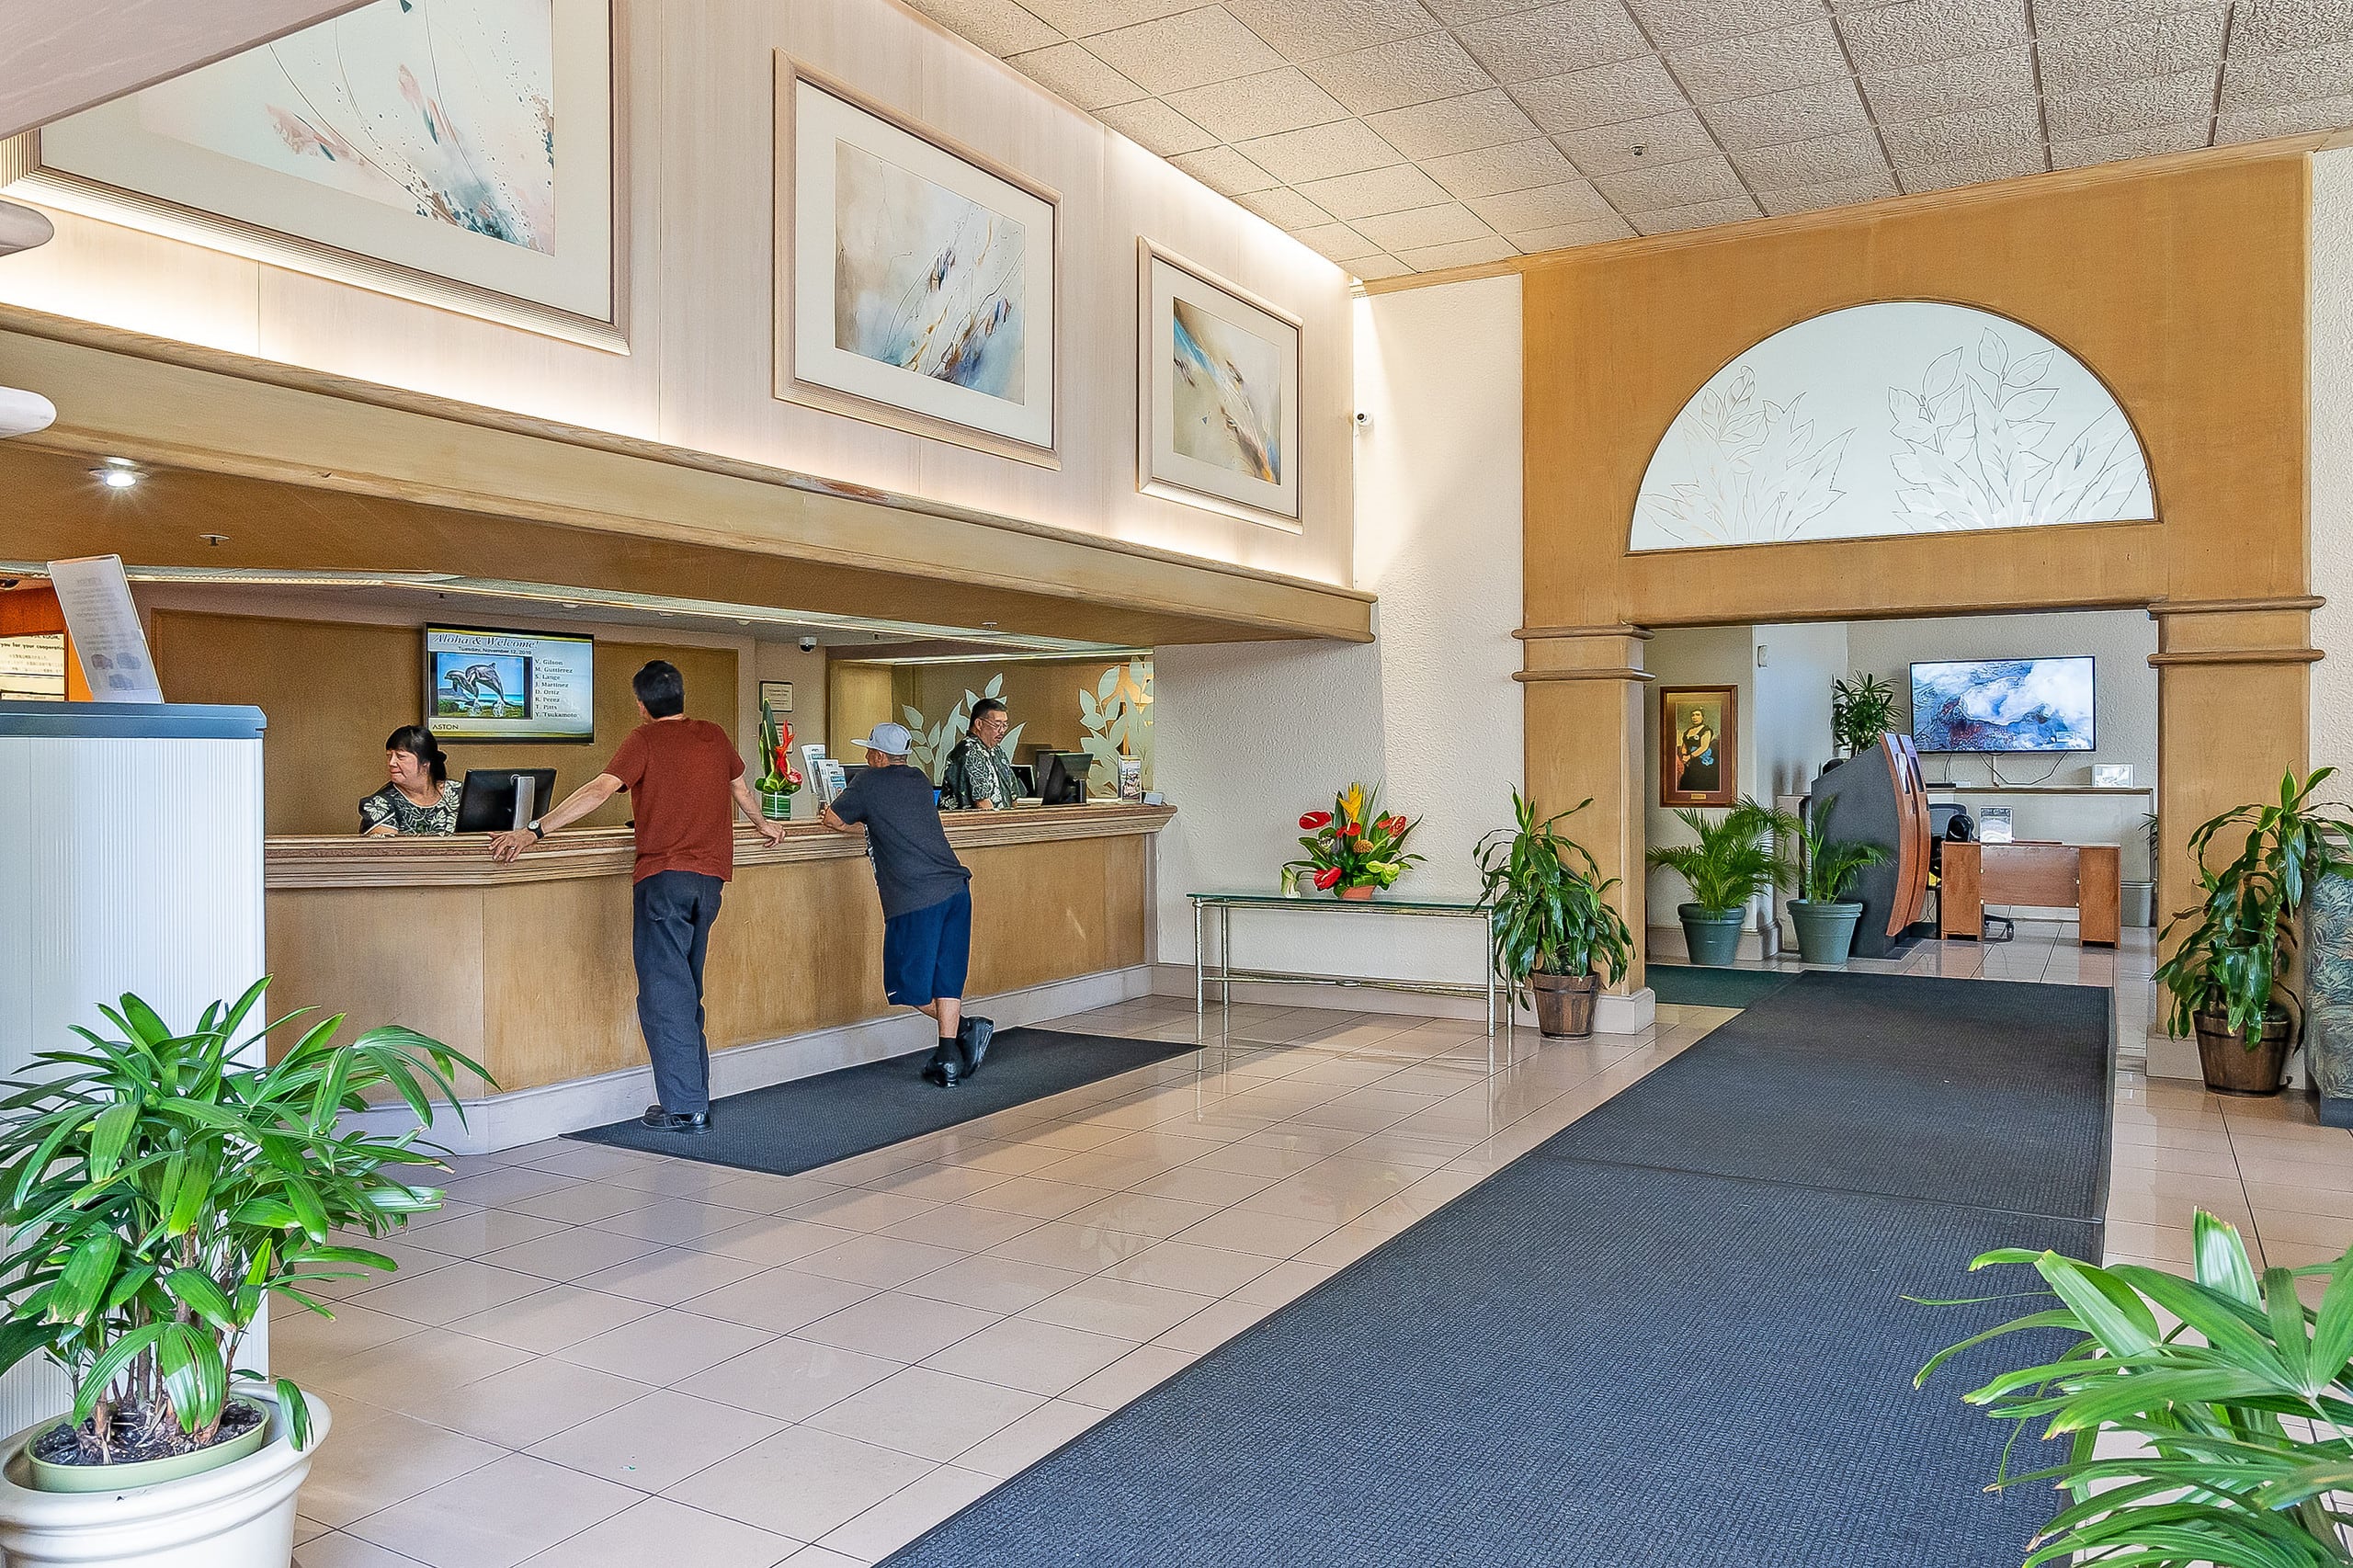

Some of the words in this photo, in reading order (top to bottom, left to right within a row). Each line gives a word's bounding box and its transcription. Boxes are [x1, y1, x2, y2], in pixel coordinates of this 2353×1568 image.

[434, 633, 468, 644] Aloha
[472, 636, 482, 645] &
[487, 637, 539, 649] Welcome!
